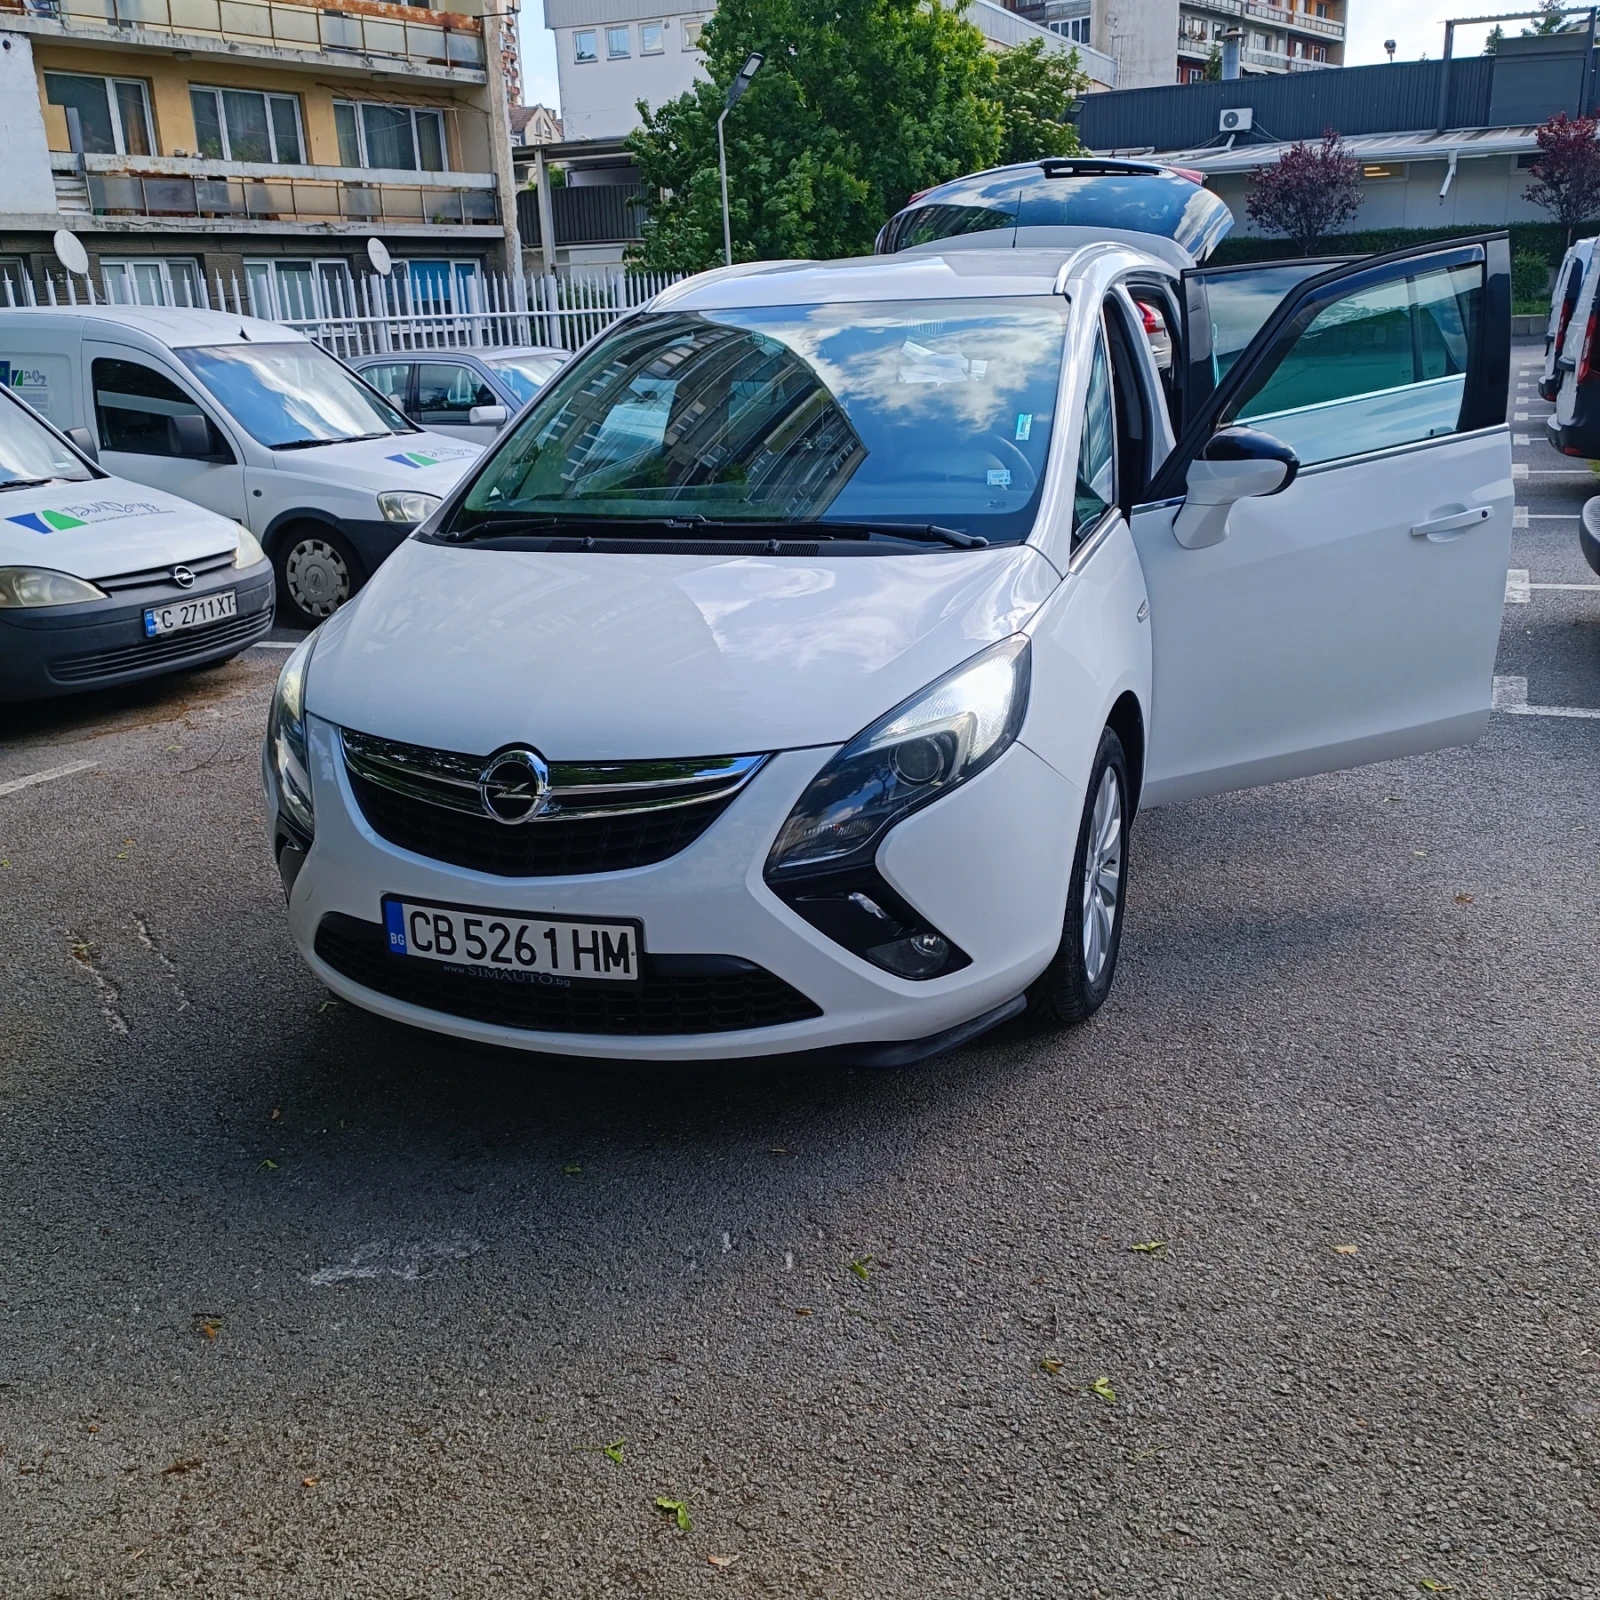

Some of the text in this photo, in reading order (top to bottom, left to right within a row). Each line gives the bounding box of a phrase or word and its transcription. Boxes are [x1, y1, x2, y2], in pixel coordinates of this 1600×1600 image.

[162, 610, 173, 628] C
[390, 932, 405, 945] BG
[442, 963, 571, 987] www.SIMAUTO.bg
